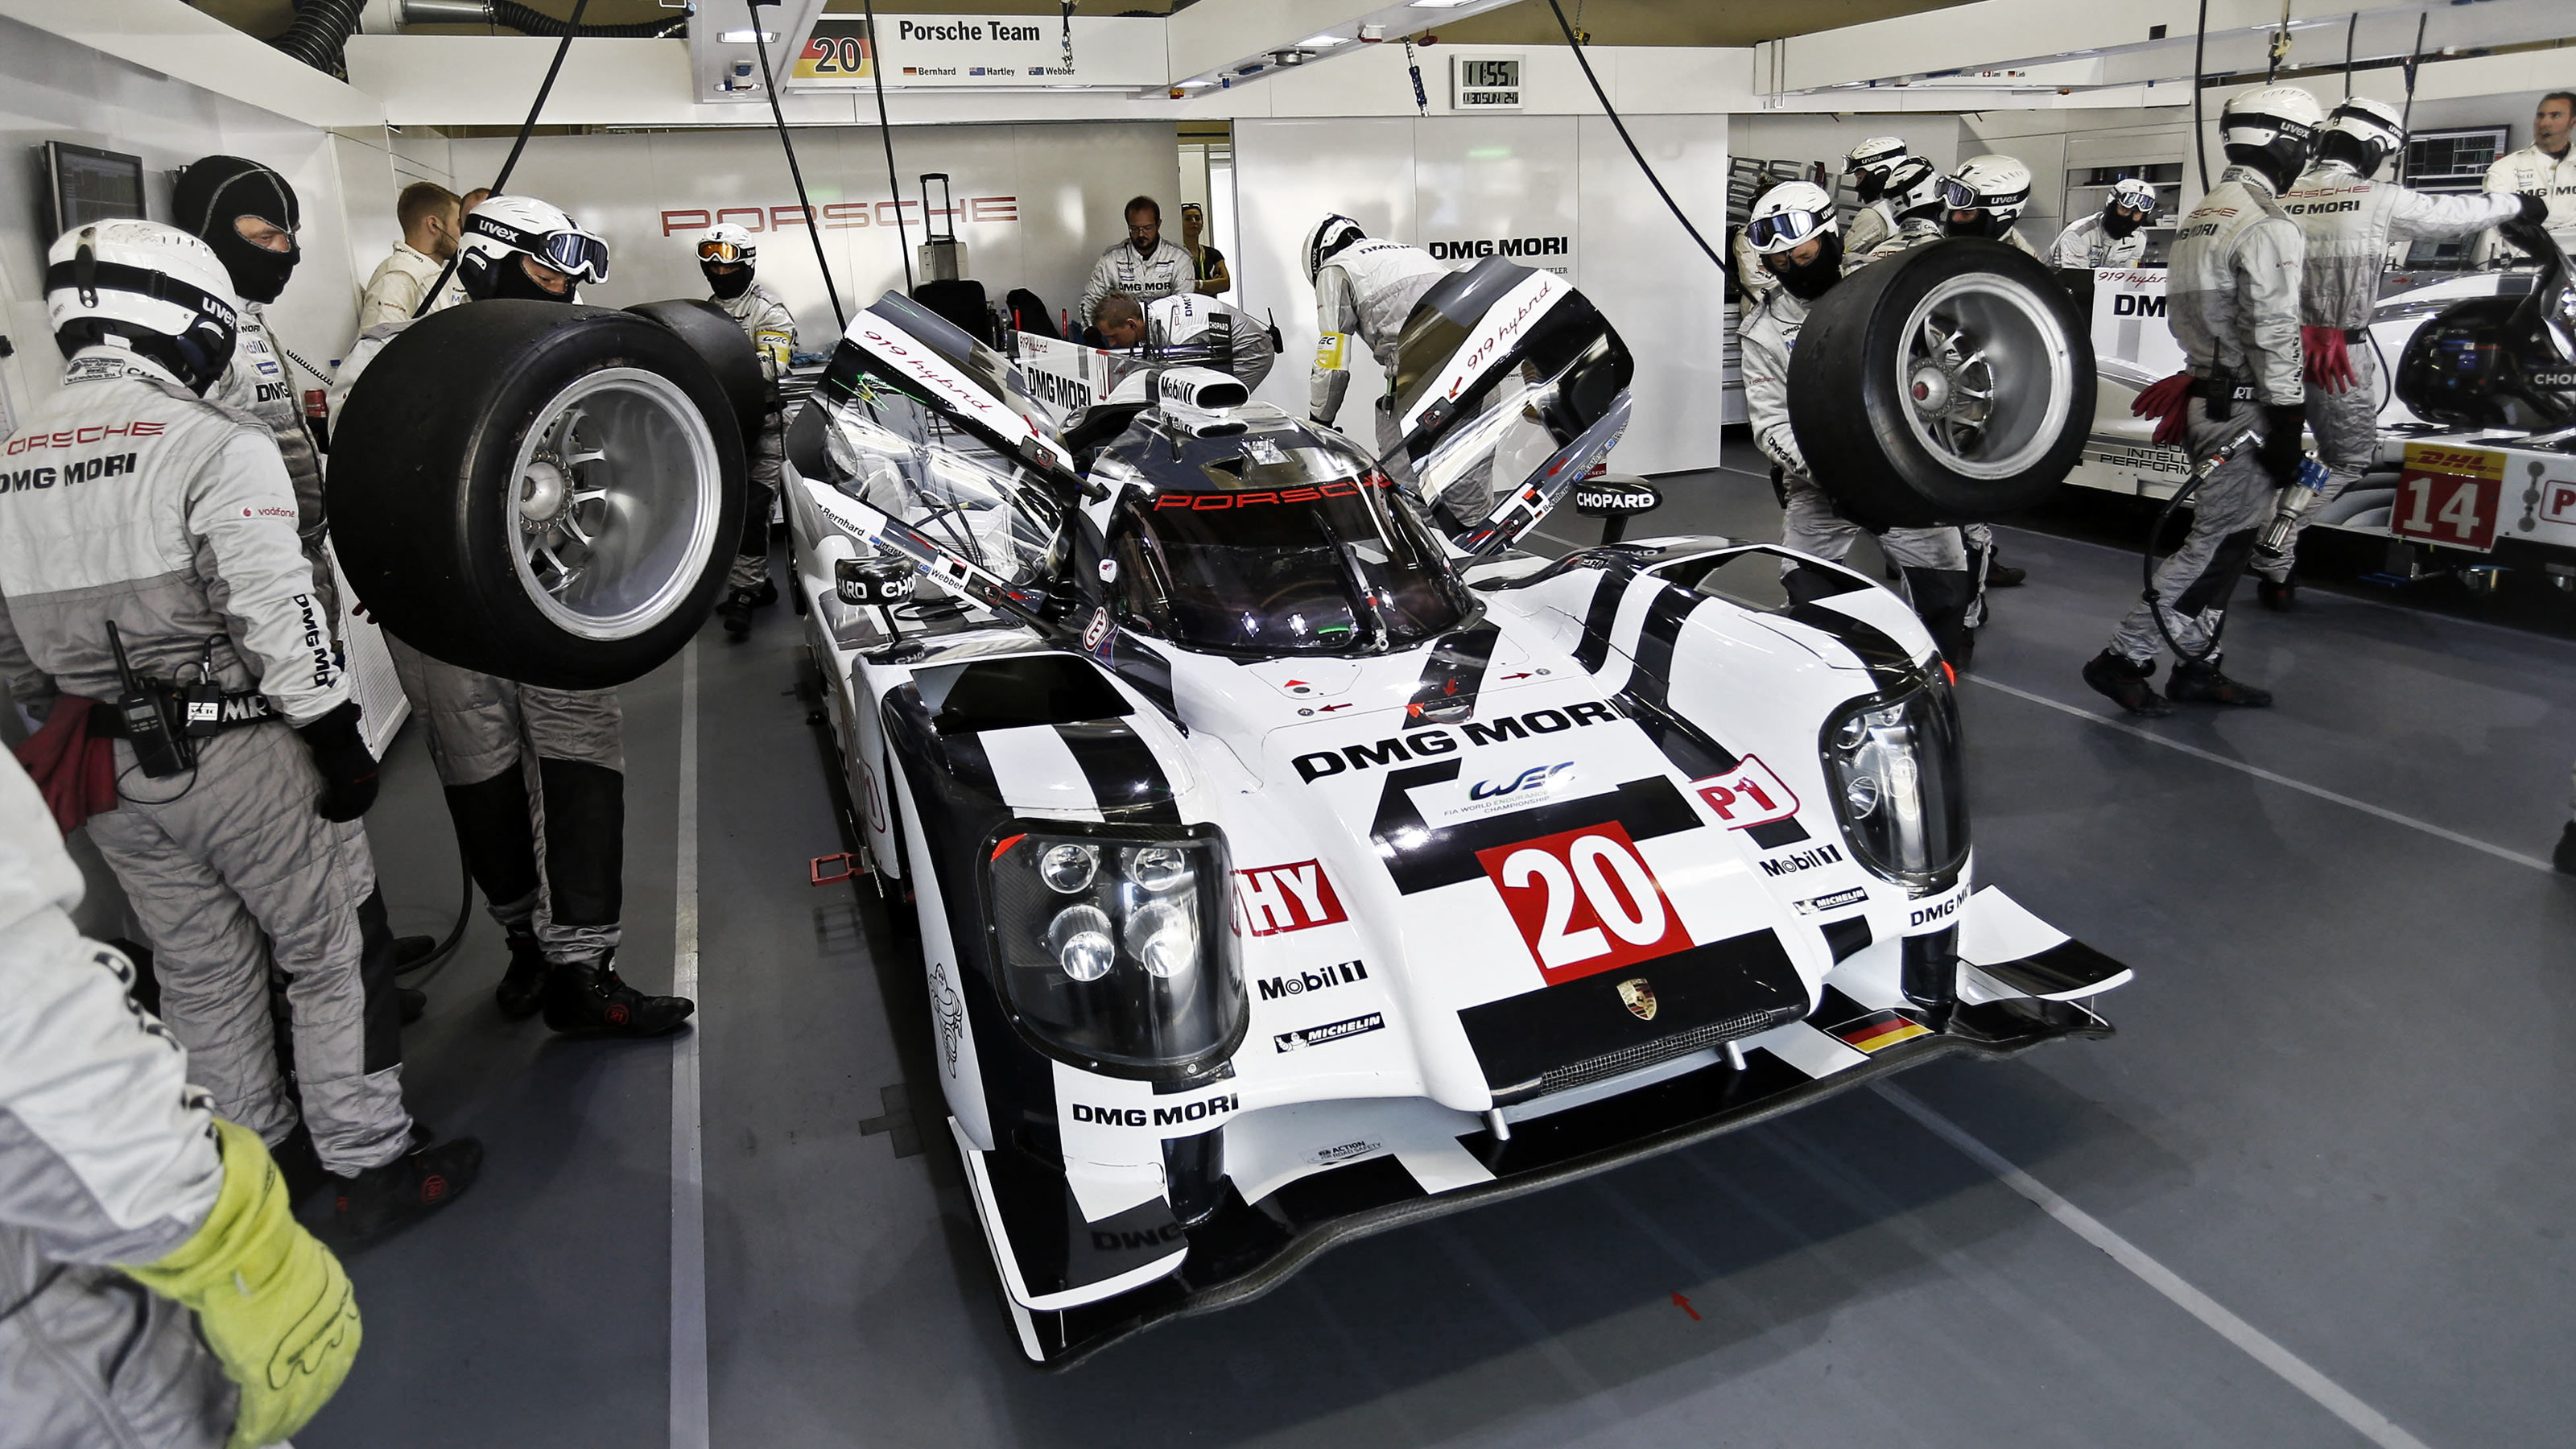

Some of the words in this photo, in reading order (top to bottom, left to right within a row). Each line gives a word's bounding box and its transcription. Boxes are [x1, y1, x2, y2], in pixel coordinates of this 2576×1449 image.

[899, 20, 982, 41] Porsche
[988, 21, 1040, 41] Team
[812, 37, 863, 73] 20
[919, 66, 956, 76] Bernhard
[986, 66, 1015, 77] Hartley
[1046, 66, 1075, 76] Webber
[2280, 121, 2310, 138] uvex
[661, 196, 1018, 237] PORSCHE
[2307, 200, 2360, 214] MORI
[479, 219, 521, 242] uvex
[1429, 241, 1493, 260] DMG
[1499, 236, 1568, 258] MORI
[1145, 282, 1171, 291] MOR
[2098, 271, 2125, 282] 919
[2125, 271, 2167, 289] hybr
[2113, 294, 2167, 318] DM
[1467, 336, 1494, 370] 919
[1498, 281, 1552, 342] hybrid
[1318, 336, 1335, 345] EC
[863, 330, 908, 356] 919
[906, 360, 993, 414] hybrid
[2533, 374, 2576, 385] CHO
[1028, 365, 1055, 403] DMG
[1055, 375, 1092, 411] MORI
[6, 421, 168, 456] ORSCHE
[2100, 453, 2192, 476] PERFORM
[2127, 447, 2190, 465] INTELL
[2419, 450, 2489, 472] DHL
[64, 452, 137, 487] MORI
[1576, 493, 1656, 509] CHOPARD
[2402, 477, 2480, 539] 14
[821, 506, 865, 537] Bernhard
[881, 574, 916, 598] CHO
[930, 568, 964, 592] Webber
[293, 593, 320, 647] DMG
[312, 650, 336, 688] MO
[1290, 729, 1459, 786] DMG
[1459, 698, 1626, 747] MORI
[1468, 761, 1575, 802] WEC
[1443, 809, 1459, 817] FIA
[1460, 801, 1492, 813] WORLD
[1493, 790, 1549, 806] ENDURANCE
[1484, 795, 1550, 814] CHAMPIONSHIP
[1696, 776, 1777, 820] P1
[1758, 849, 1821, 877] Mobil
[1816, 843, 1843, 865] 1
[1235, 863, 1330, 932] HY
[1501, 834, 1666, 970] 20
[1815, 889, 1865, 909] MICHELIN
[1909, 898, 1955, 927] DMG
[1956, 882, 1971, 909] MO
[1257, 966, 1340, 1001] Mobil
[1339, 959, 1368, 984] 1
[1307, 1014, 1381, 1041] MICHELIN
[1071, 1103, 1147, 1127] DMG
[1153, 1092, 1239, 1126] MORI
[1332, 1140, 1366, 1154] ACTION
